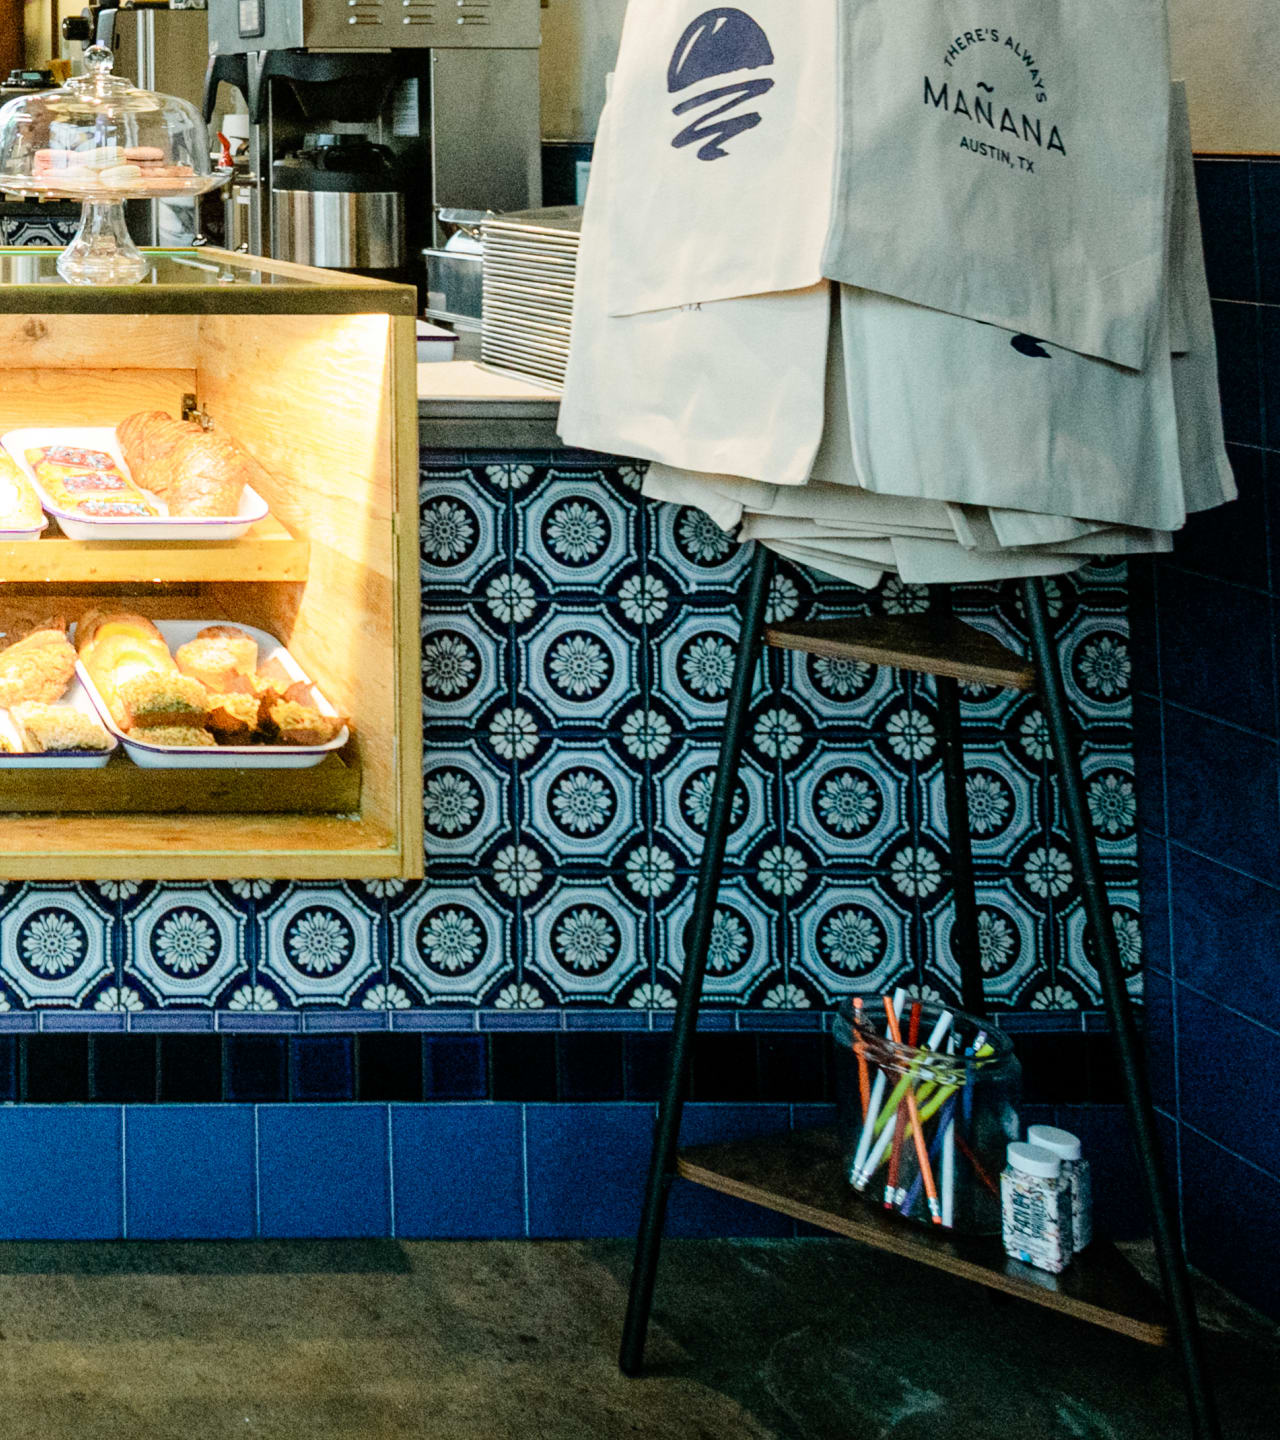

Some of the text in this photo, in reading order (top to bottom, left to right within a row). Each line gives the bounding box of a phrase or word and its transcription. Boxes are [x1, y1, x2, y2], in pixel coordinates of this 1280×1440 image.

[943, 27, 1048, 104] THERE'S ALWAYS
[923, 75, 1067, 157] MAÑANA
[959, 135, 1035, 174] AUSTIN, TX
